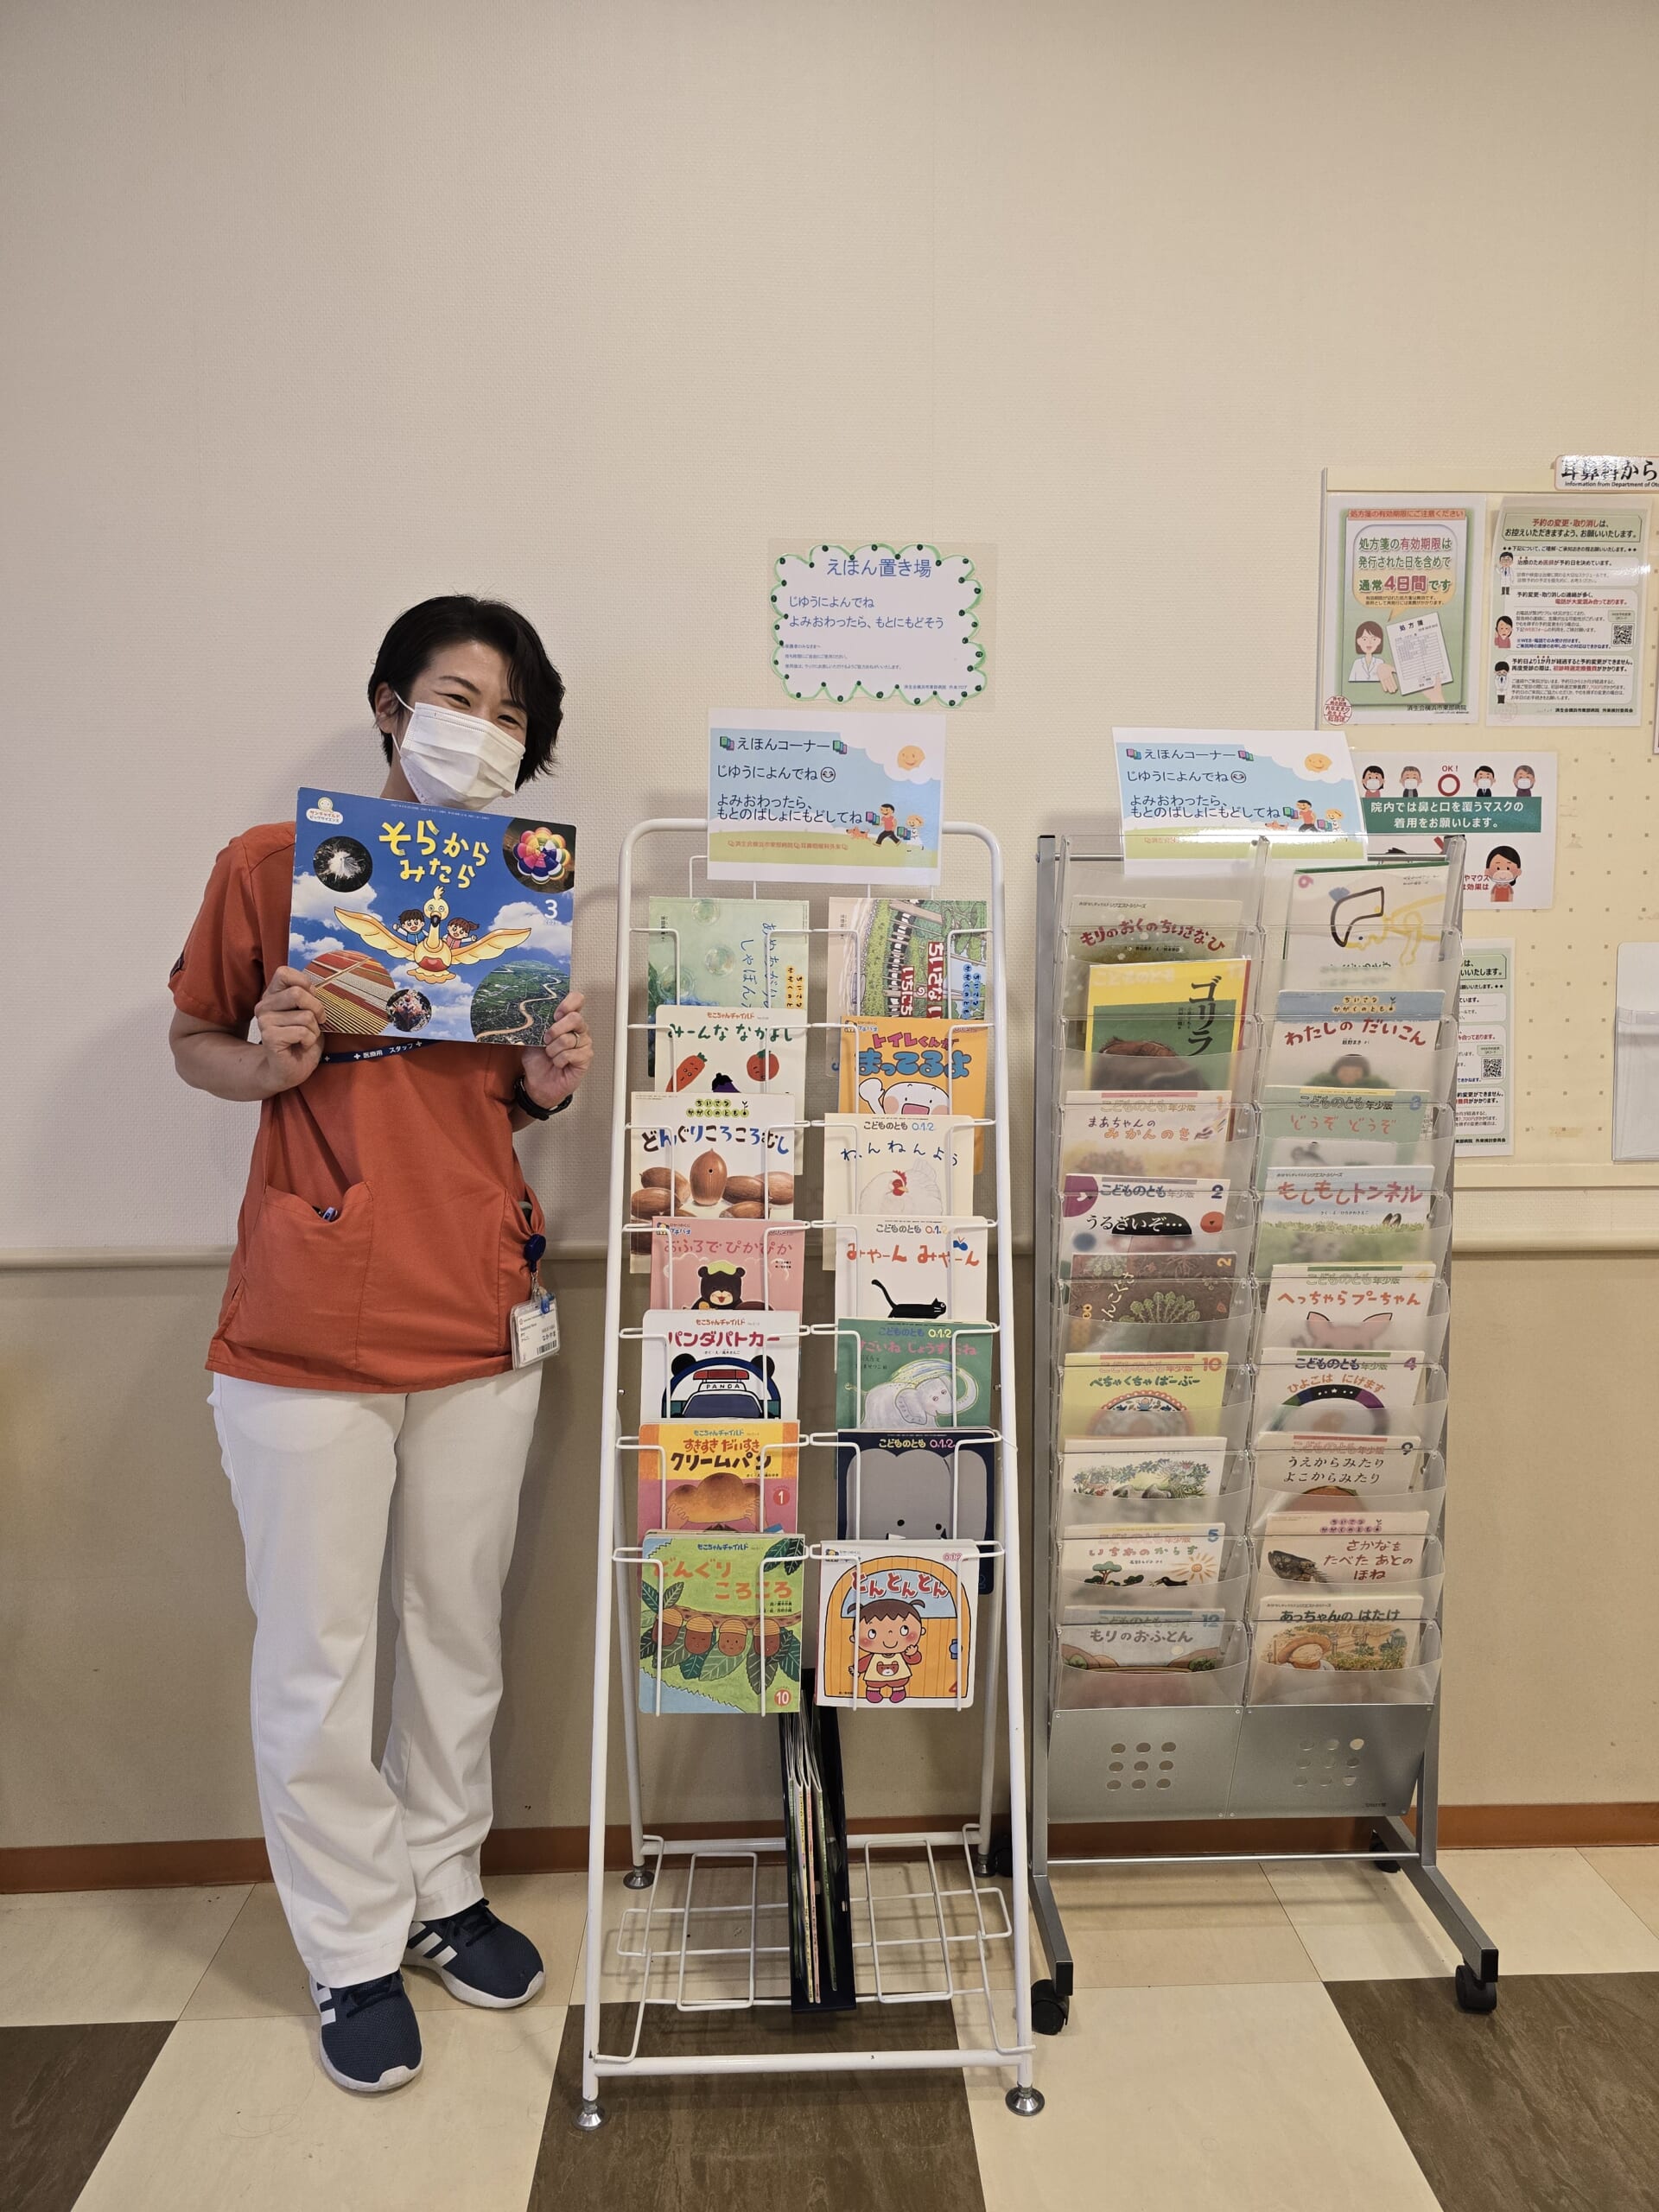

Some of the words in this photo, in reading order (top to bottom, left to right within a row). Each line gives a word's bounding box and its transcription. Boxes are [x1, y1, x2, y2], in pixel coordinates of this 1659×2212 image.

[1359, 537, 1452, 550] 処方箋の有効期限は
[827, 558, 931, 578] えほん置き場
[1358, 556, 1451, 569] 発行された日を含めて
[1359, 575, 1451, 592] 通常4日間です
[789, 596, 874, 608] じゆうによんでね
[738, 737, 830, 751] えほんコーナー
[1144, 749, 1236, 760] えほんコーナー
[717, 765, 817, 780] じゆうによんでね
[1127, 771, 1229, 783] じゆうによんでね
[717, 793, 812, 809] よみおわったら、
[1130, 794, 1227, 806] よみおわったら、
[1370, 801, 1524, 813] 院内では鼻と口を覆うマスクの
[717, 807, 863, 824] もとのばしょにもどしてね
[1130, 805, 1281, 818] もとのばしょにもどしてね
[1394, 817, 1498, 829] 着用をお願いします。
[378, 820, 490, 867] そらから
[399, 858, 475, 889] みたら
[544, 899, 558, 919] 3
[927, 943, 944, 1001] ちいさな
[900, 967, 914, 1016] いちにち
[1188, 976, 1222, 1057] ゴリラ
[1284, 1020, 1354, 1046] わたしの
[1362, 1017, 1427, 1046] だいこん
[855, 1047, 972, 1079] まってるよ
[863, 1122, 908, 1130] こどものとも
[1088, 1116, 1156, 1128] まあちゃんの
[1291, 1115, 1338, 1131] どうぞ
[1349, 1117, 1397, 1135] どうぞ
[1104, 1128, 1191, 1141] みかんのき
[1211, 1185, 1224, 1199] 2
[1277, 1179, 1423, 1205] もしもしトンネル
[876, 1224, 922, 1234] こどものとも
[847, 1243, 907, 1264] みゃーん
[1217, 1257, 1232, 1267] 2
[669, 1331, 780, 1347] パンダパトカー
[879, 1327, 925, 1338] こどものとも
[1202, 1357, 1223, 1372] 10
[1403, 1357, 1417, 1371] 4
[1287, 1373, 1333, 1394] ひよこは
[1342, 1373, 1386, 1392] にげます
[683, 1438, 719, 1453] すきすき
[721, 1438, 760, 1453] だいすき
[879, 1439, 926, 1448] こどものとも
[1401, 1441, 1414, 1455] 9
[671, 1452, 772, 1471] クリームパン
[1288, 1457, 1384, 1469] うえからみたり
[1284, 1471, 1381, 1484] よこからみたり
[778, 1491, 784, 1504] 1
[1208, 1529, 1219, 1542] 5
[1346, 1540, 1402, 1552] さかなを
[1323, 1554, 1370, 1567] たべた
[1376, 1554, 1414, 1567] あとの
[653, 1557, 731, 1579] どんぐり
[1354, 1569, 1386, 1580] ほね
[715, 1581, 792, 1600] ころころ
[851, 1571, 949, 1599] とんとんとん
[1201, 1614, 1220, 1628] 12
[1280, 1611, 1353, 1623] あっちゃんの
[1359, 1609, 1401, 1622] はたけ
[1090, 1629, 1194, 1643] もりのおふとん
[776, 1691, 789, 1705] 10
